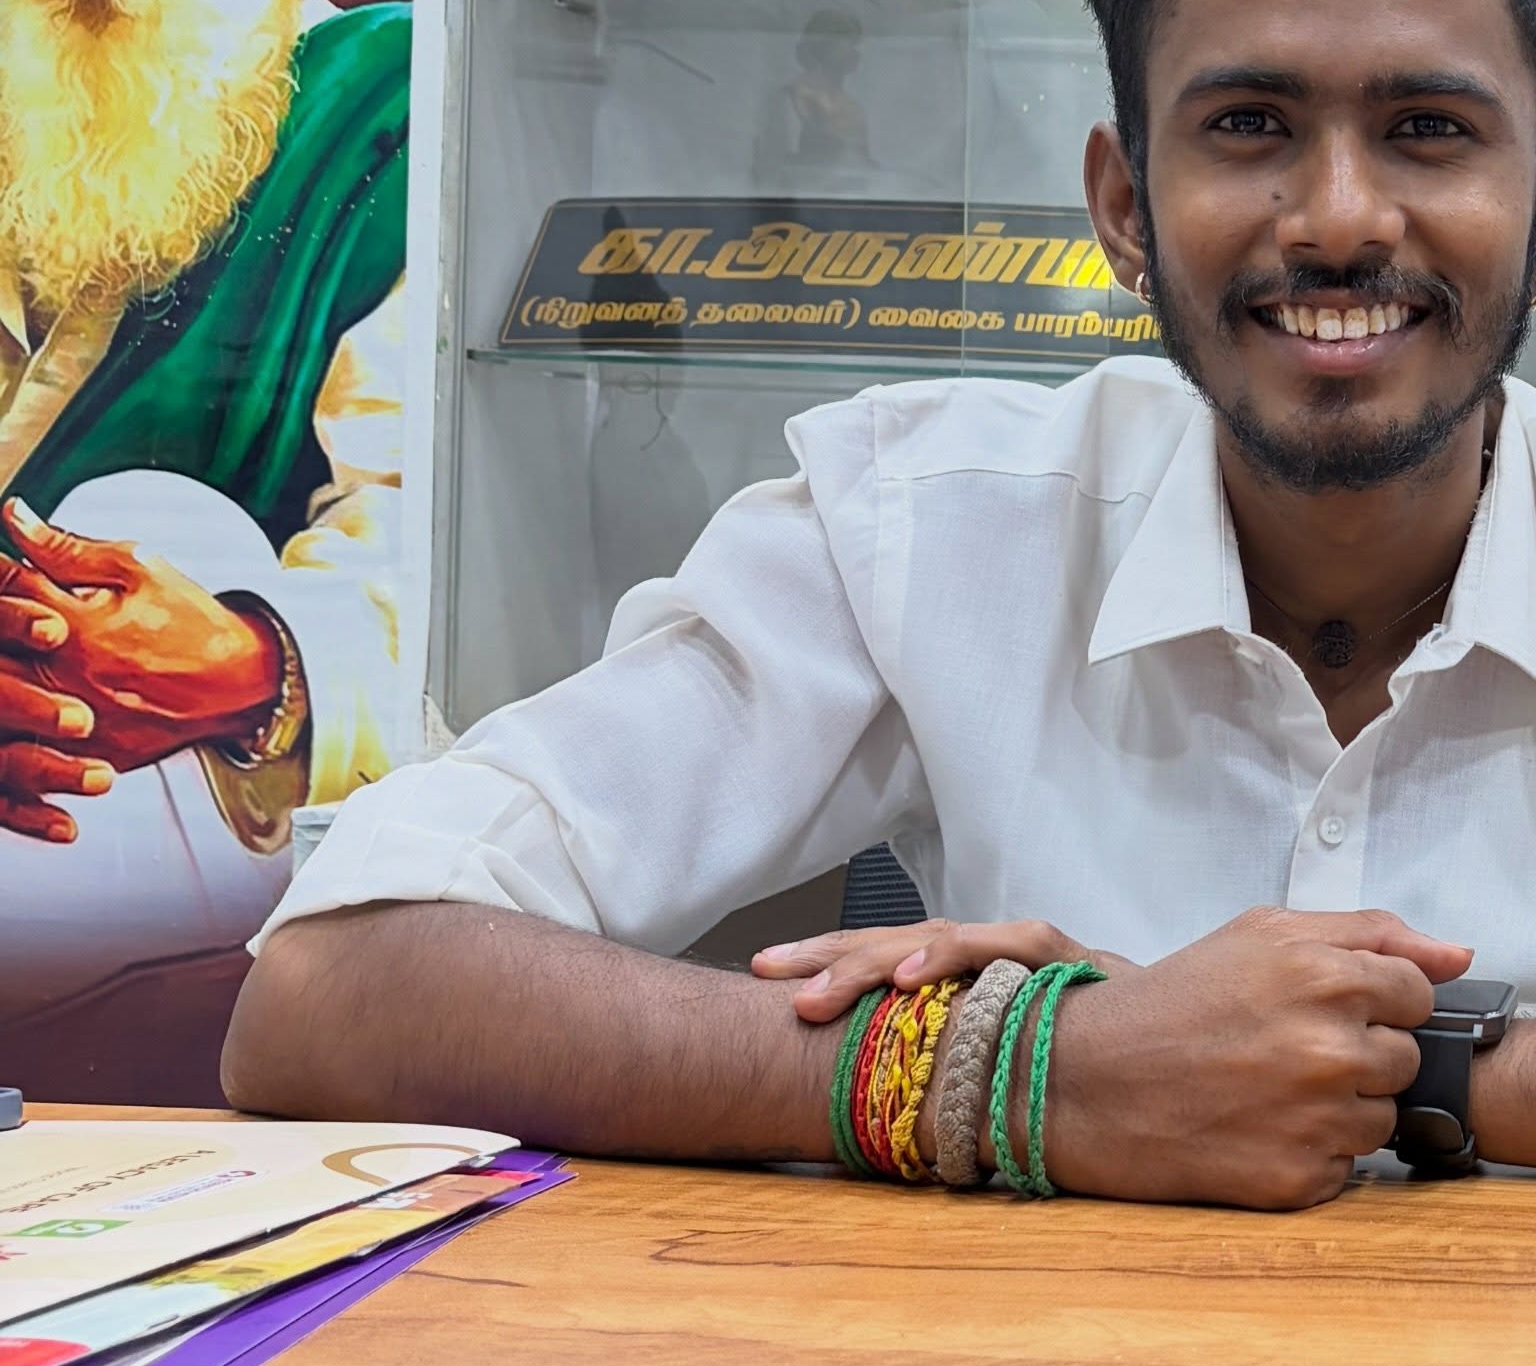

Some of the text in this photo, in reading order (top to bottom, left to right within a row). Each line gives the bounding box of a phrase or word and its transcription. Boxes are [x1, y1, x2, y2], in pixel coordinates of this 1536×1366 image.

[578, 221, 1115, 290] கா.அருண்பா
[520, 295, 1162, 342] (நிறுவனத் தலைவர்) வைகை பாரம்பரி
